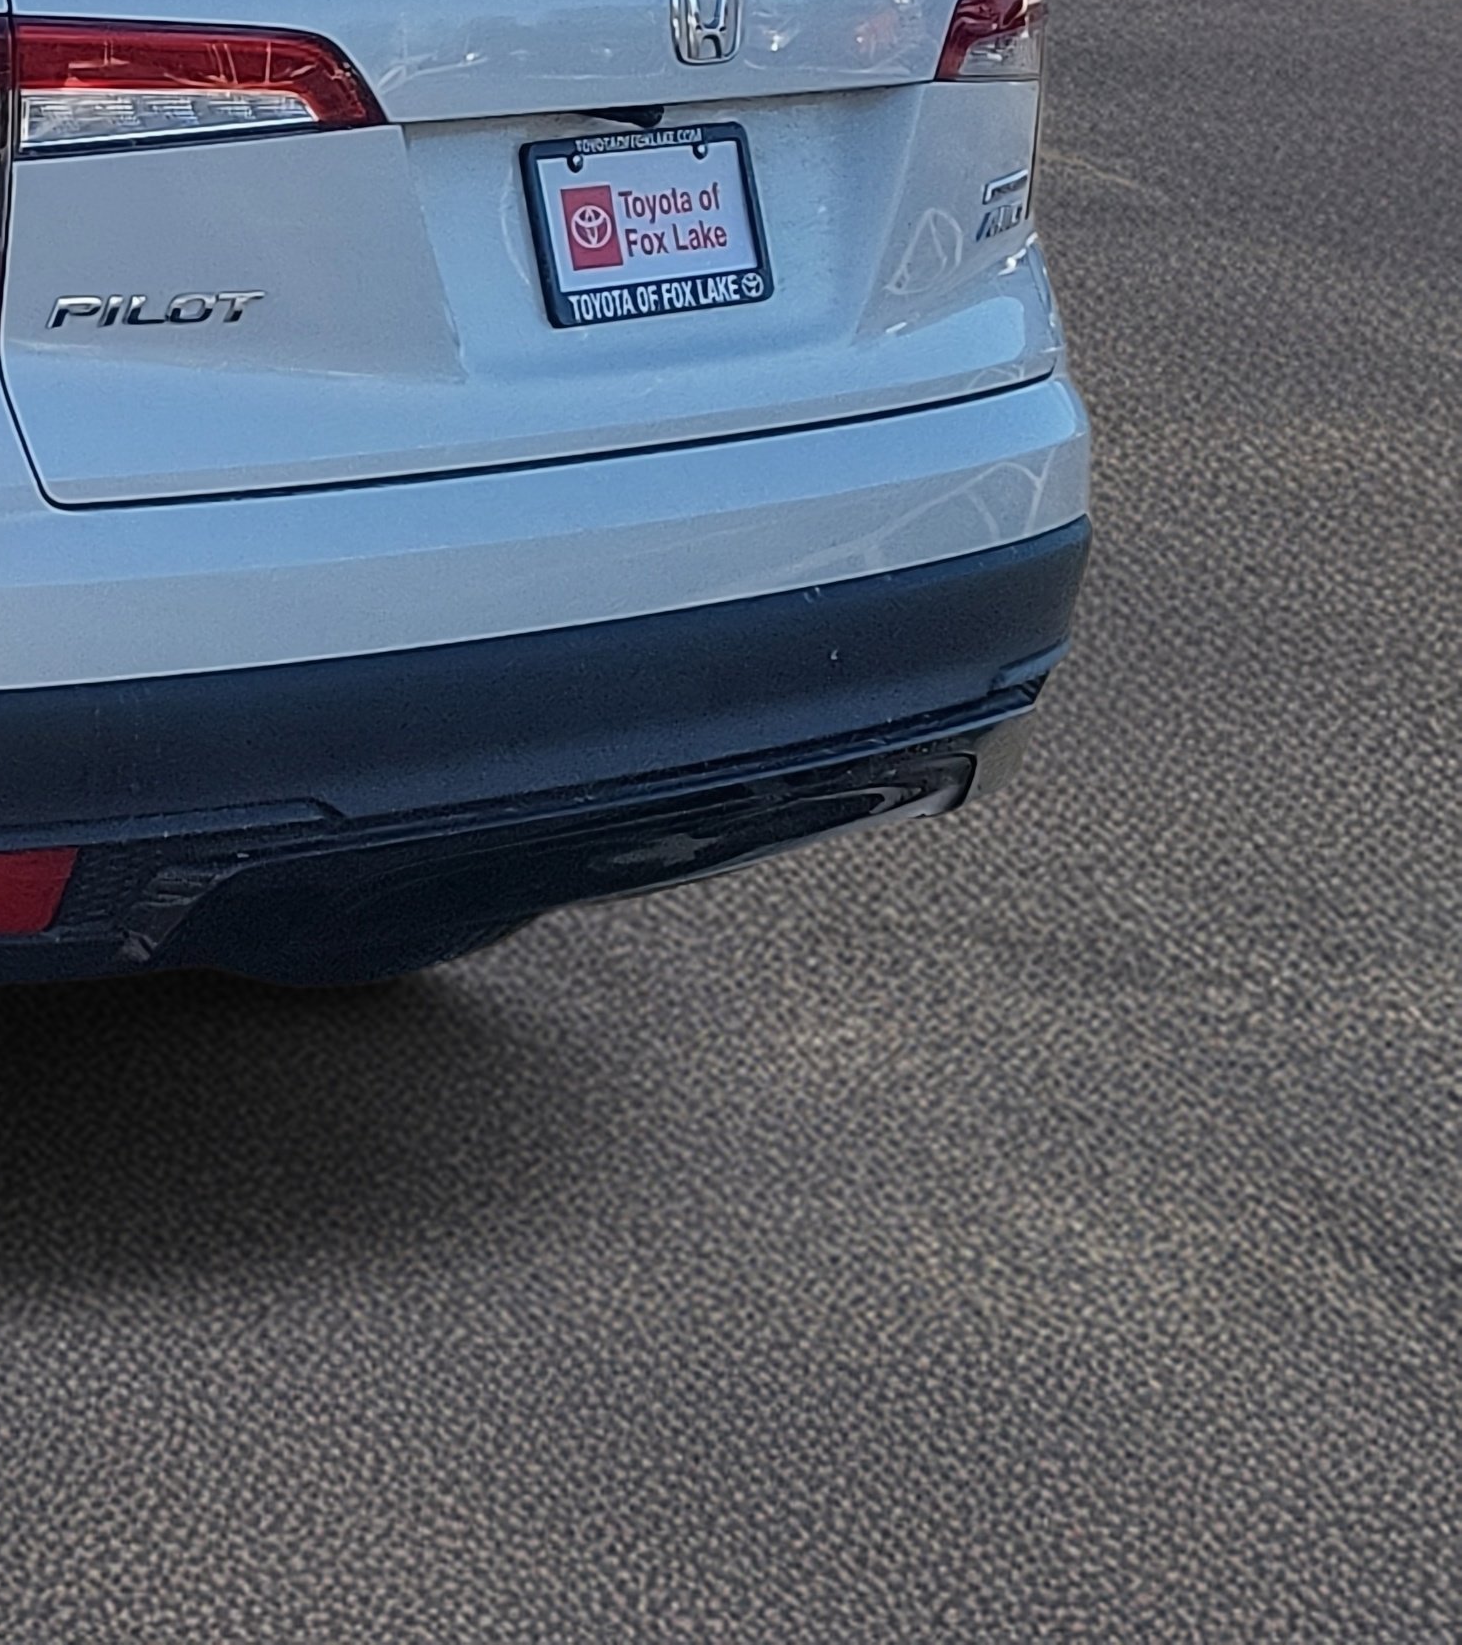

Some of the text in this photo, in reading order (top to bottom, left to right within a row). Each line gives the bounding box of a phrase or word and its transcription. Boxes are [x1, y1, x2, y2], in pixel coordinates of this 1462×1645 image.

[617, 182, 720, 224] Toyota of
[624, 220, 728, 257] Fox Lake
[45, 289, 267, 329] PILOT
[568, 274, 741, 323] TOYOTA OF FOX LAKE
